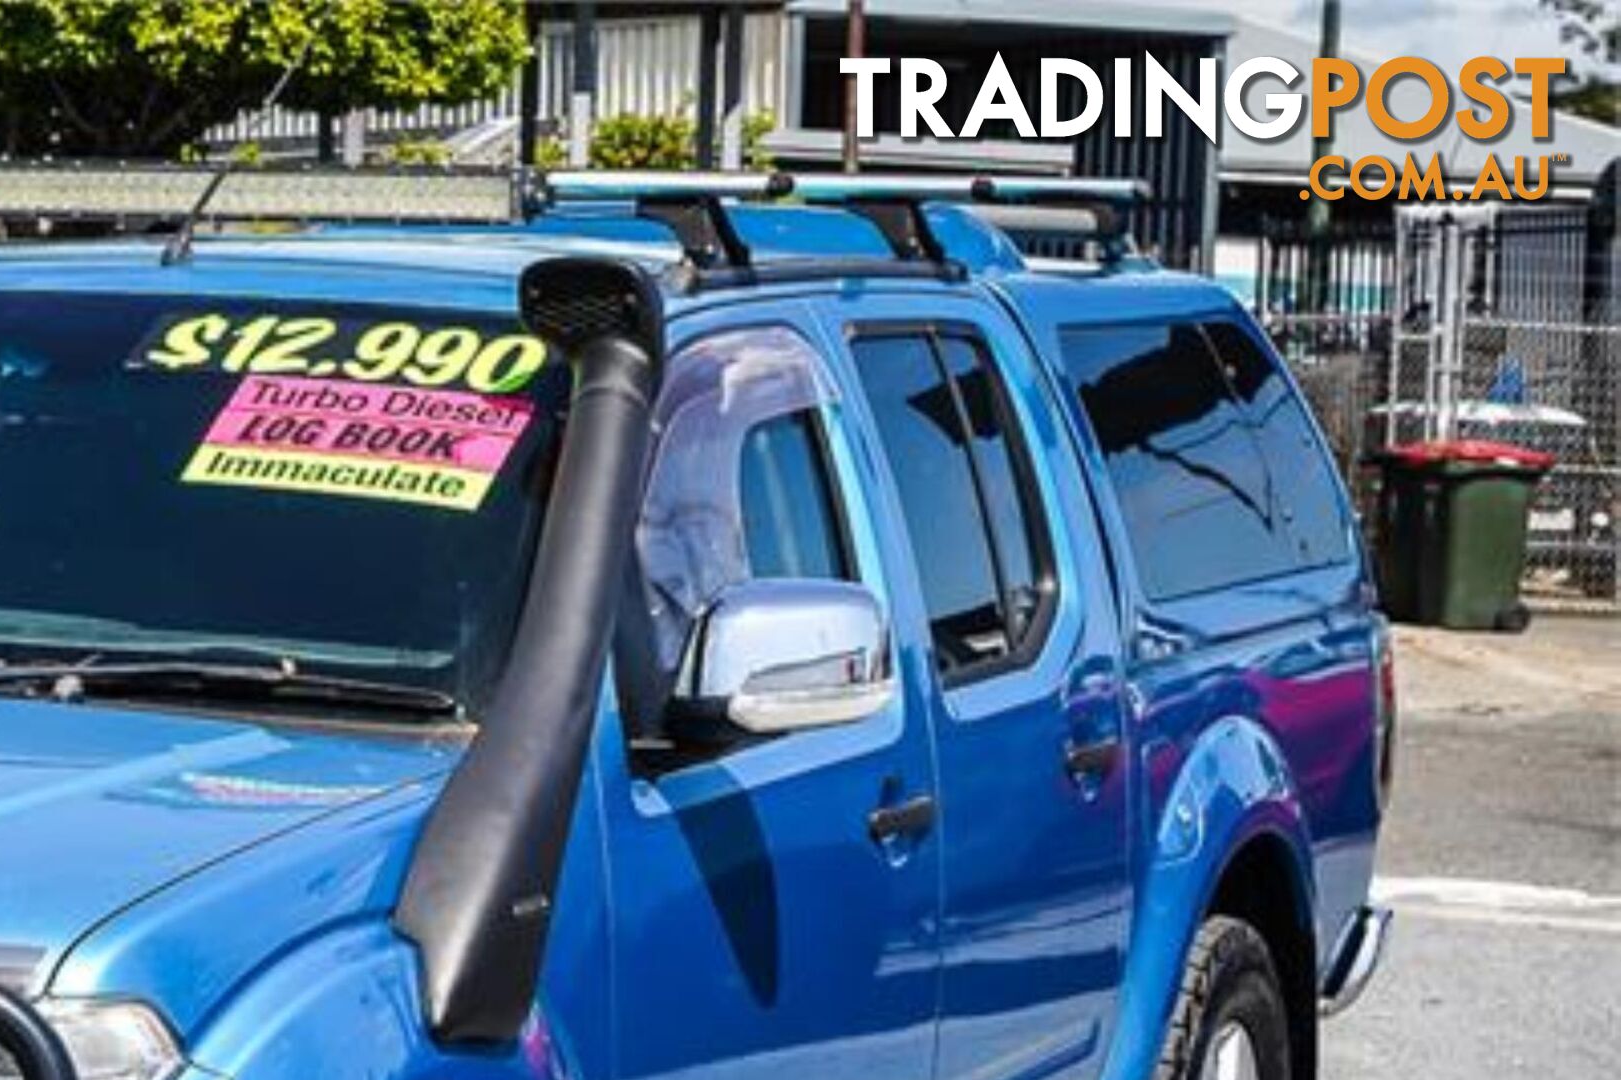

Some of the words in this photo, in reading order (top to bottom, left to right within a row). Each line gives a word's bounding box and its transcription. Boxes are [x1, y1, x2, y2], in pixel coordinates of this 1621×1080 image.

[251, 381, 369, 413] Turbo
[382, 390, 516, 427] Diesel
[237, 414, 326, 445] LOG
[332, 421, 463, 459] BOOK
[204, 450, 467, 499] Immaculate
